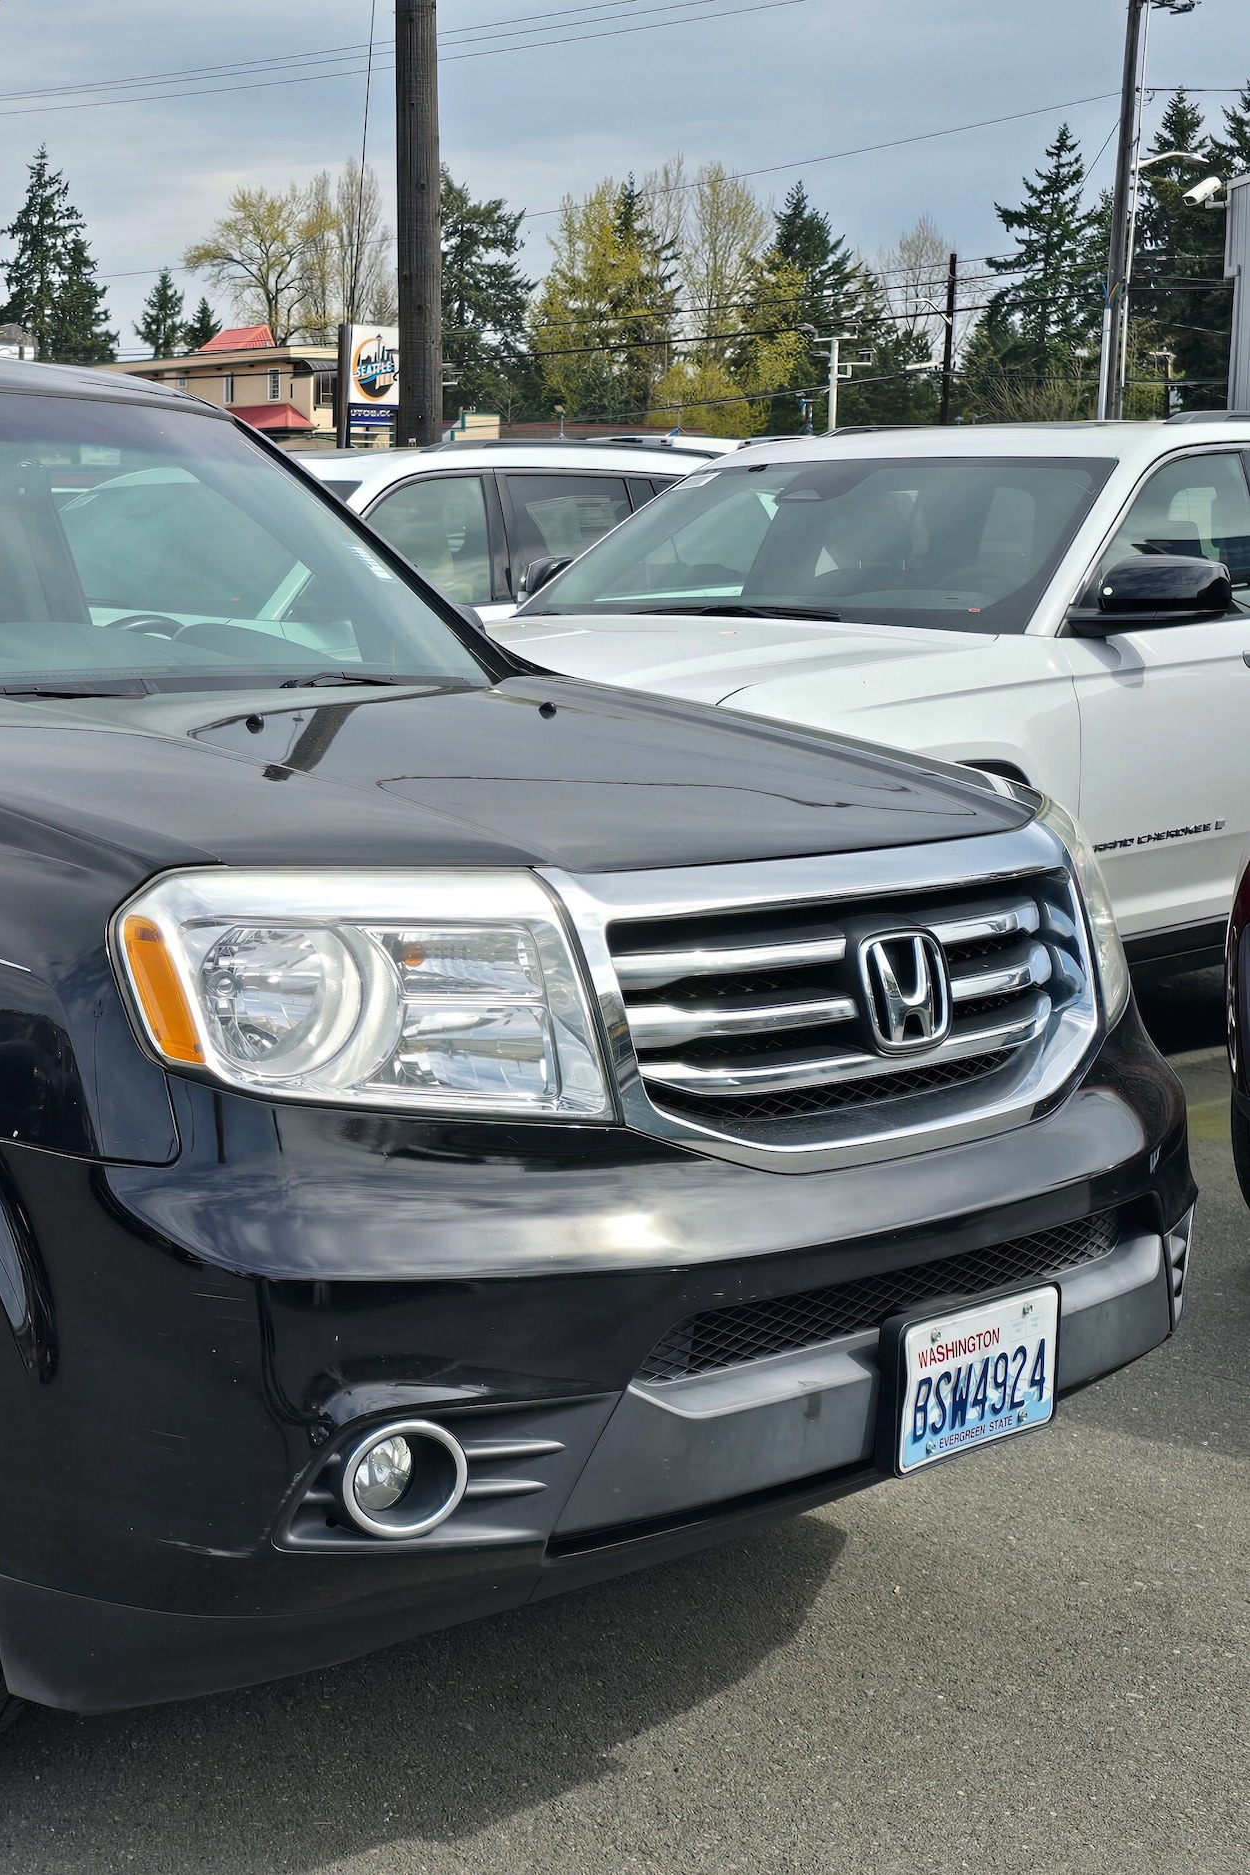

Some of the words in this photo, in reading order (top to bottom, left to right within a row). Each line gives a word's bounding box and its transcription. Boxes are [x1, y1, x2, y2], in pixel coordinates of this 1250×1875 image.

[354, 360, 393, 377] SEATTLE
[1092, 837, 1135, 853] RAND
[1137, 823, 1212, 845] CHEROKEE
[918, 1327, 1001, 1369] WASHINGTON
[912, 1338, 1046, 1443] BSW4924
[938, 1424, 986, 1449] EVERGREEN
[988, 1415, 1013, 1433] STATE
